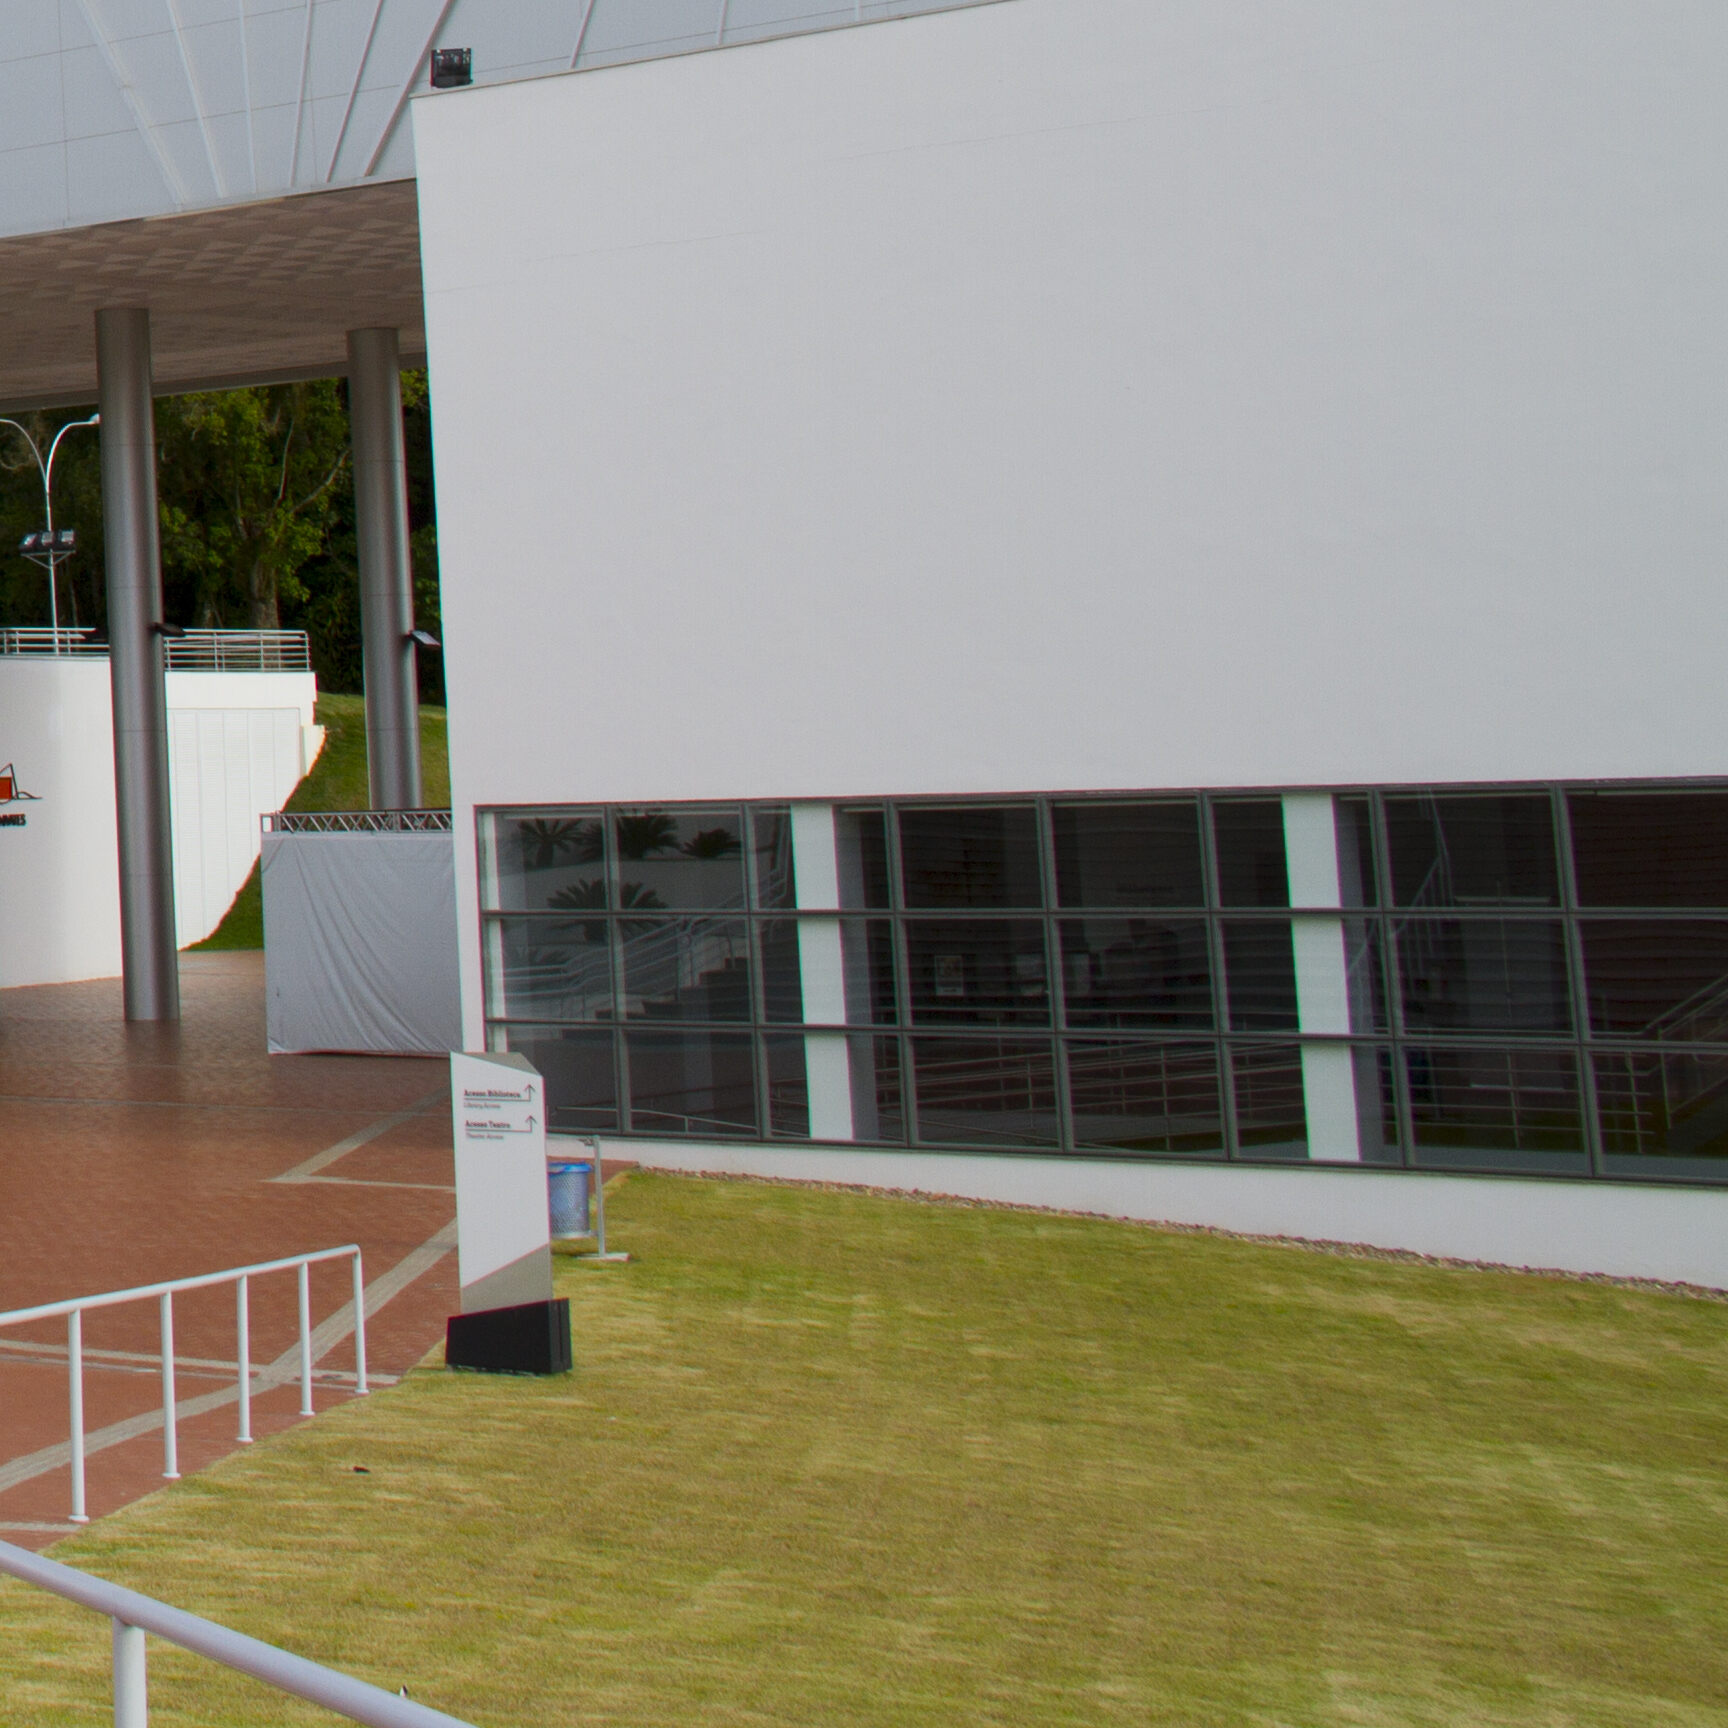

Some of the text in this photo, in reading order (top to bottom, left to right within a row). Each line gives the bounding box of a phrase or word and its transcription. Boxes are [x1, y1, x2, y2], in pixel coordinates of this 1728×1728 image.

[464, 1089, 521, 1098] Acesso Biblioteca
[465, 1120, 511, 1129] Acesso Teatro
